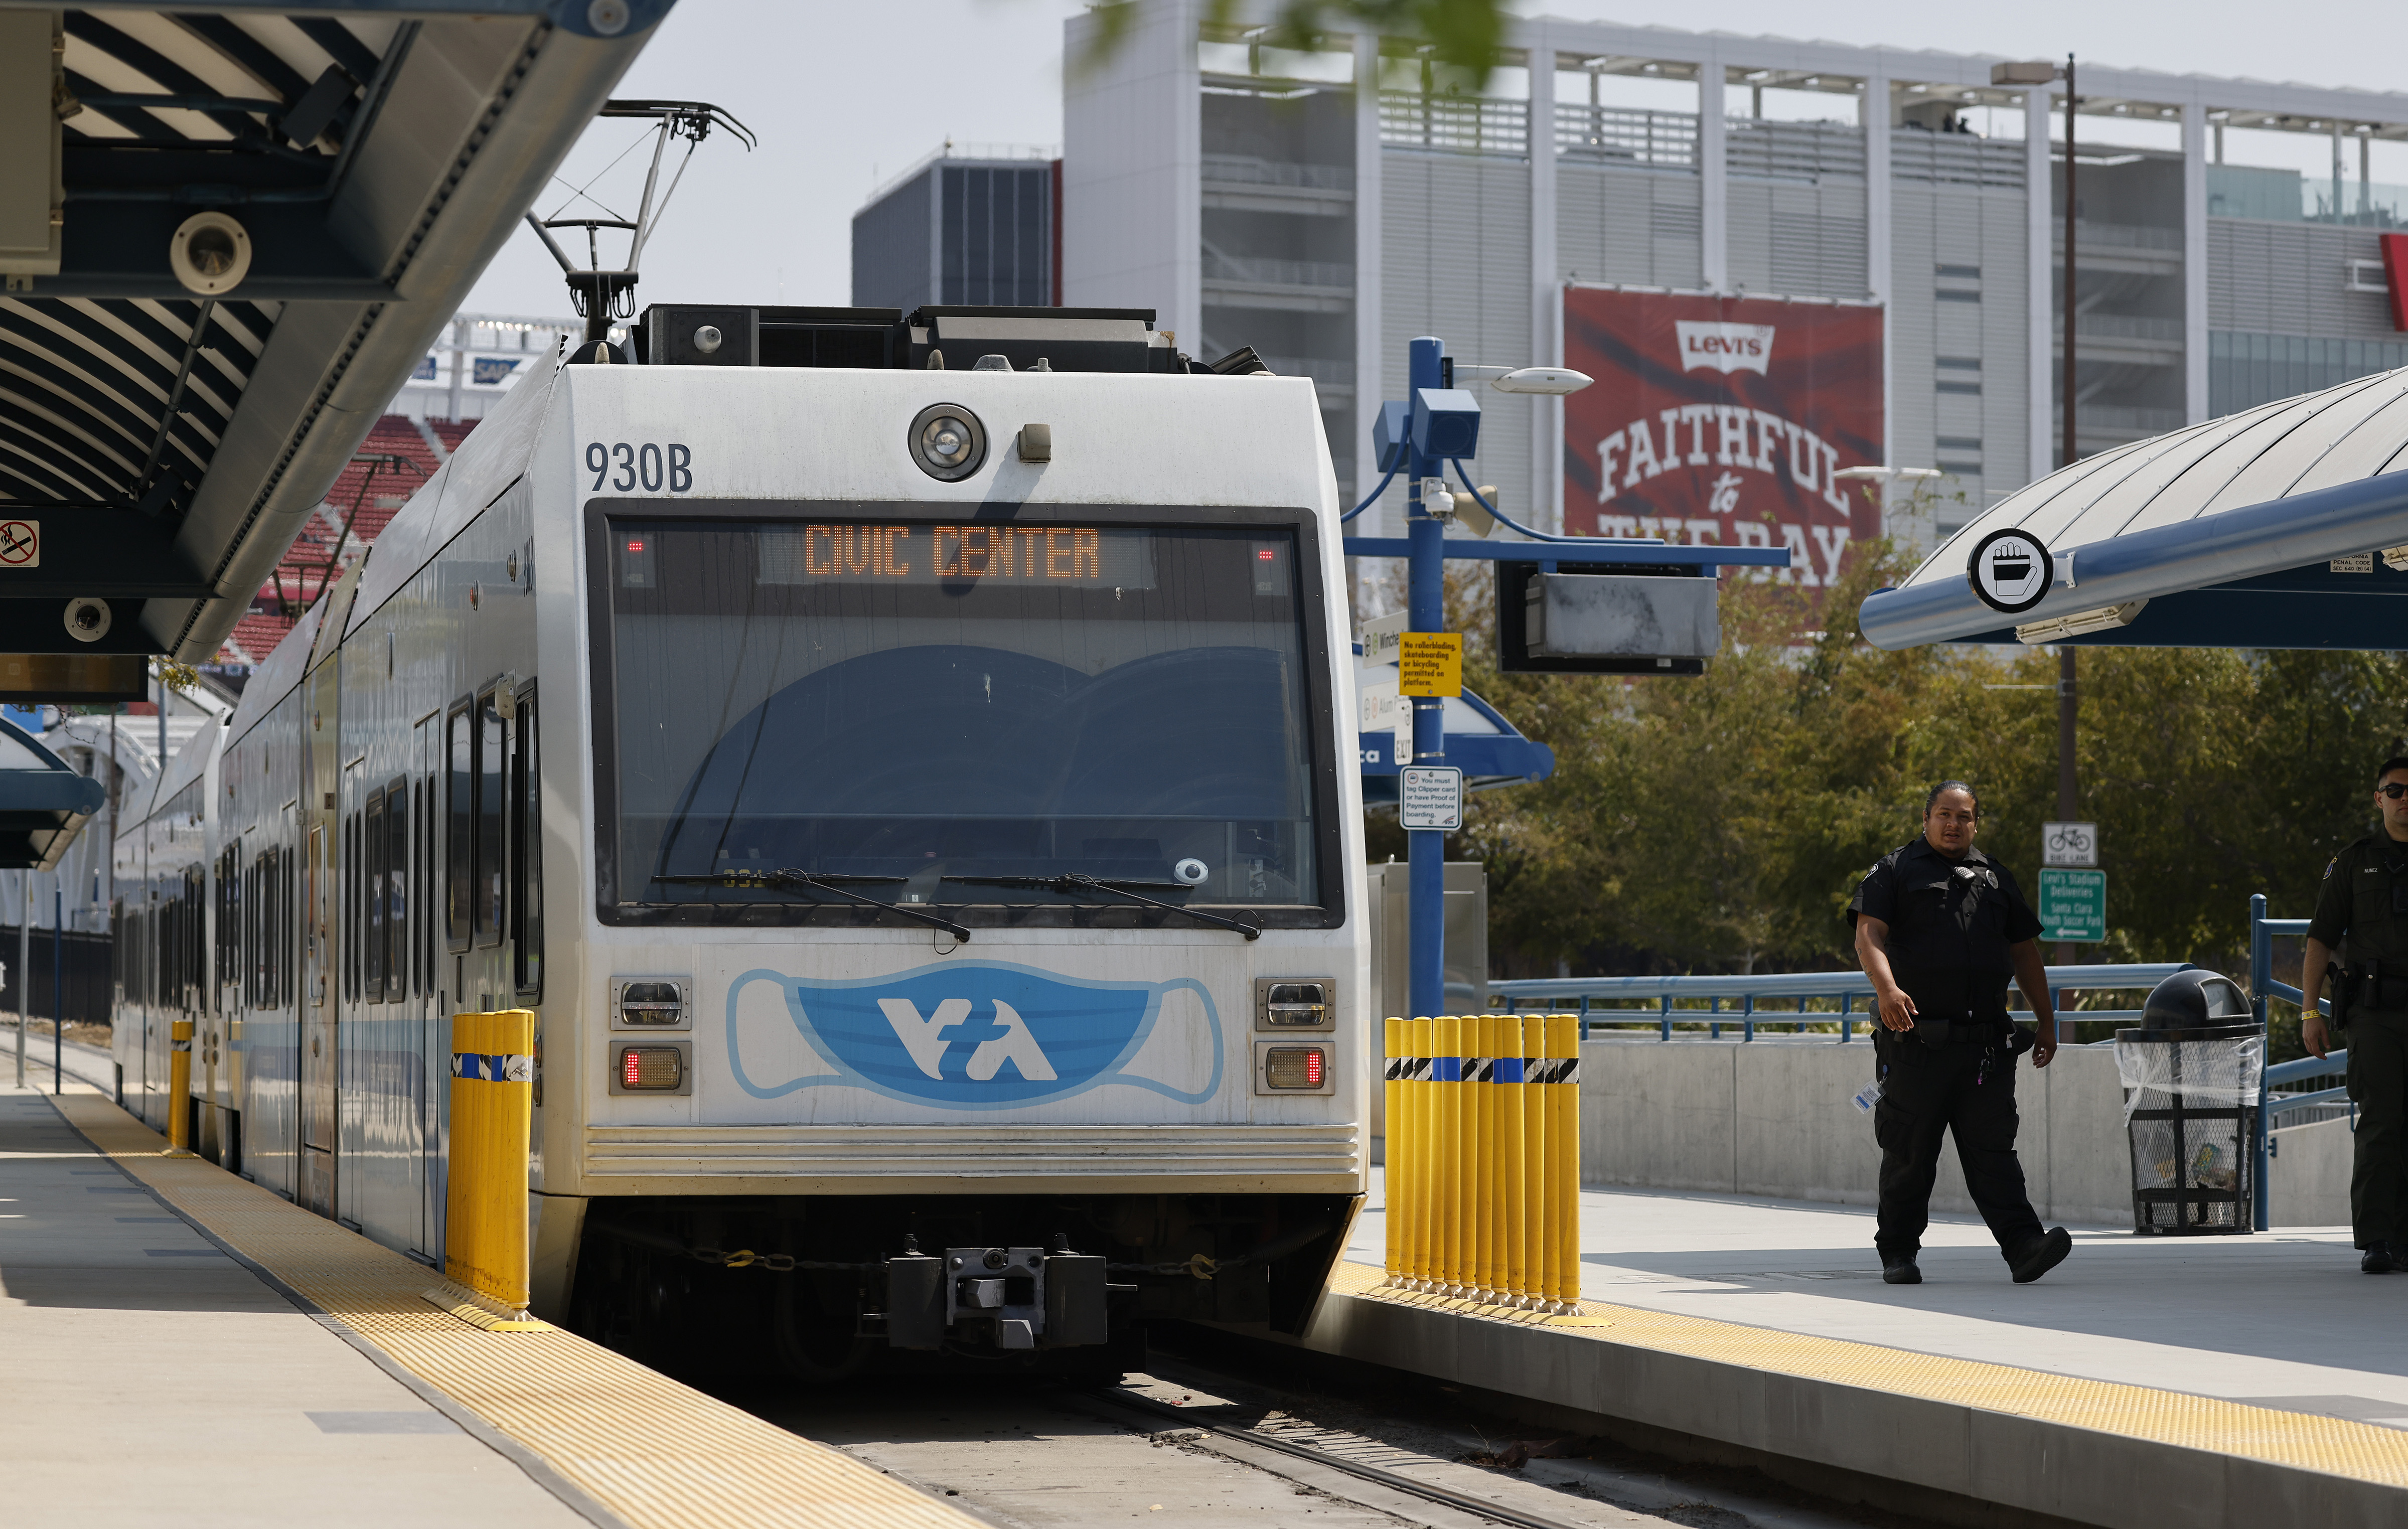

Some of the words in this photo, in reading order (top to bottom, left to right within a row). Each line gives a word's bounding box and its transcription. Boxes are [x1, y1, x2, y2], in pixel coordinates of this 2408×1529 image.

[1597, 403, 1850, 518] FAITHFUL
[586, 442, 692, 493] 930B
[1708, 470, 1744, 514] to
[805, 524, 909, 576] CIVIC
[933, 526, 1099, 577] CENTER
[1415, 641, 1457, 651] rollerblading,
[1404, 651, 1449, 660] skateboarding
[1412, 660, 1440, 669] bicycling
[1404, 670, 1435, 678] permitted
[1404, 678, 1433, 687] platform.
[1379, 698, 1393, 714] Alum
[1396, 739, 1412, 759] EXIT
[2050, 854, 2065, 862] BIKE
[2070, 854, 2089, 862] LANE
[2043, 873, 2066, 885] Levi's
[2069, 873, 2101, 885] Stadium
[2050, 885, 2093, 898] Deliveries
[2051, 902, 2071, 914] Santa
[2073, 903, 2093, 914] Clara
[2043, 915, 2061, 926] Youth
[2063, 915, 2084, 927] Soccer
[2087, 915, 2101, 927] Park
